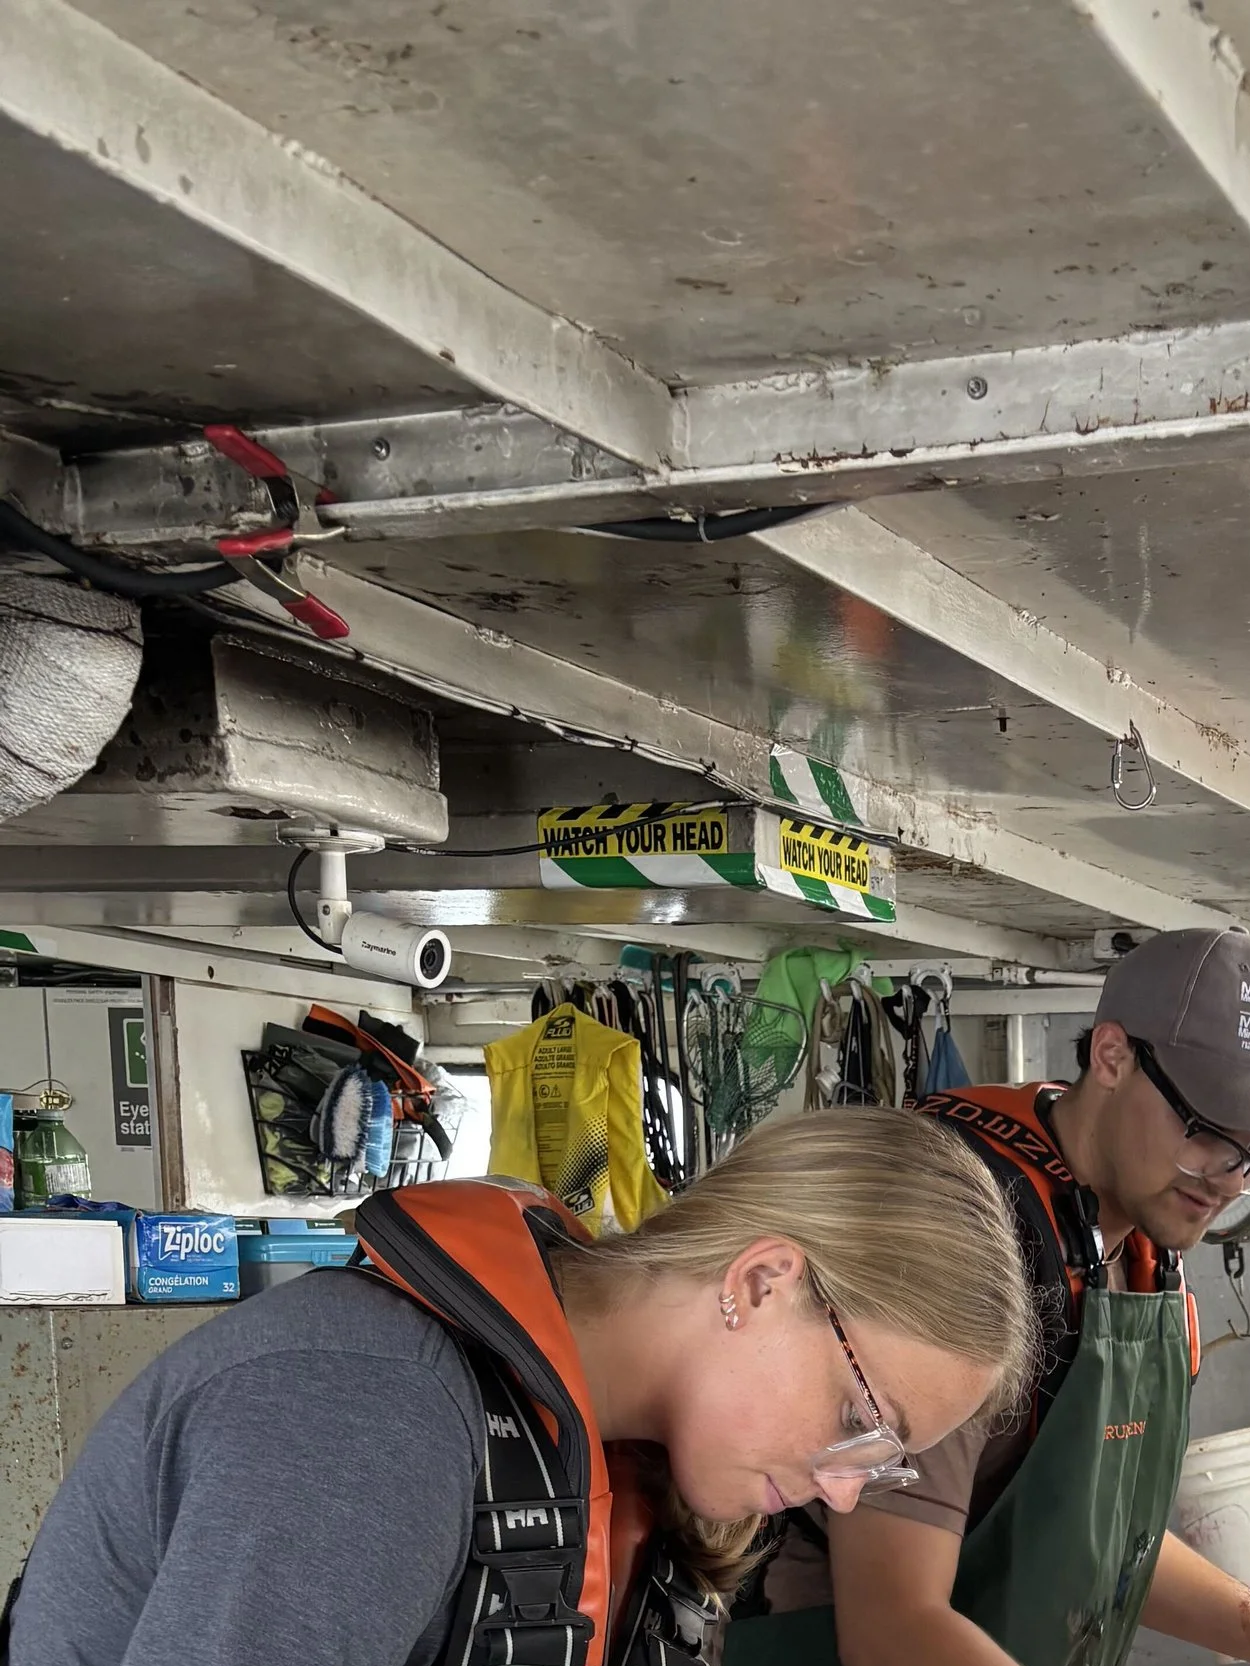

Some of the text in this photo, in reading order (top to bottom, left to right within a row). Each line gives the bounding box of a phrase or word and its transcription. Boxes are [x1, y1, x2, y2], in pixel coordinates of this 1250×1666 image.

[543, 820, 723, 857] WATCH YOUR HEAD
[781, 835, 816, 871] WATCH
[817, 846, 842, 880] YOUR
[843, 853, 869, 887] HEAD
[119, 1101, 149, 1120] Eye
[163, 1224, 225, 1260] Ziploc
[148, 1273, 209, 1287] CONGÉLATION
[222, 1282, 235, 1293] 32
[486, 1411, 521, 1439] HH
[505, 1507, 550, 1529] HH
